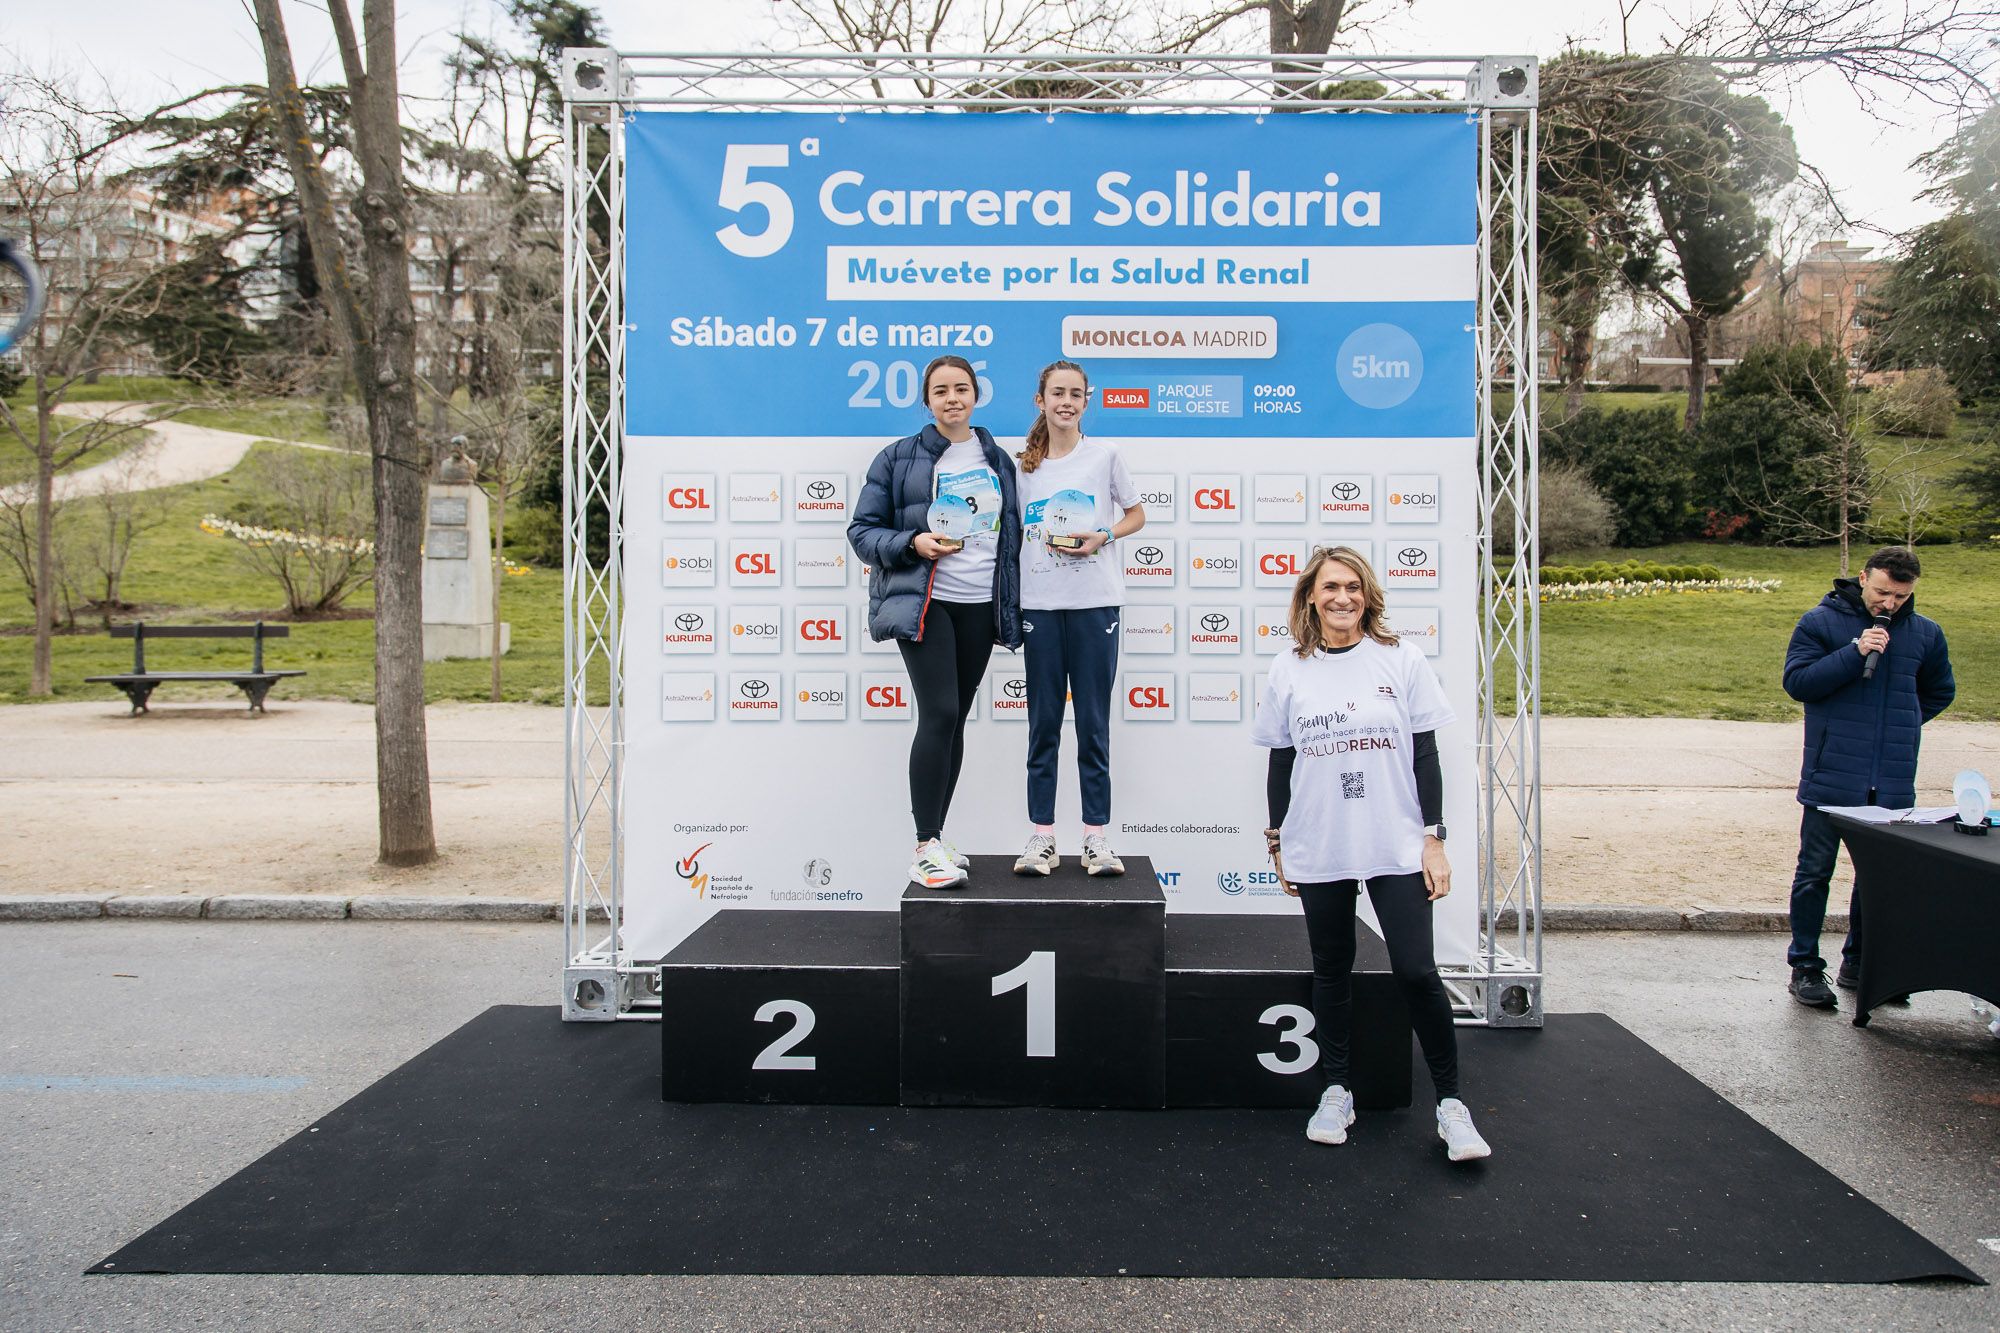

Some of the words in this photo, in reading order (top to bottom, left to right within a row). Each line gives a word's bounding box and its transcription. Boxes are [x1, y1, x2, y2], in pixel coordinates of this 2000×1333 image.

[819, 170, 1071, 226] Carrera
[1093, 170, 1380, 227] Solidaria
[848, 258, 991, 284] Muévete
[1003, 267, 1059, 291] por
[1070, 257, 1099, 284] la
[1111, 257, 1204, 284] Salud
[1217, 258, 1309, 284] Renal
[670, 316, 796, 346] Sábado
[806, 318, 827, 346] 7
[837, 316, 878, 346] de
[888, 324, 993, 347] marzo
[1072, 331, 1186, 346] MONCLOA
[1194, 331, 1266, 346] MADRID
[1352, 354, 1409, 378] 5km
[848, 361, 994, 409] 206
[1158, 384, 1213, 398] PARQUE
[1254, 384, 1296, 397] 09:00
[1107, 394, 1145, 404] SALIDA
[1158, 401, 1191, 413] DEL
[1193, 401, 1229, 413] OESTE
[1254, 401, 1301, 413] HORAS
[668, 488, 710, 509] CSL
[1140, 492, 1172, 504] sobi
[1195, 489, 1235, 510] CSL
[1403, 493, 1435, 504] sobi
[680, 557, 711, 568] sobi
[735, 553, 776, 574] CSL
[1206, 557, 1237, 569] sobi
[1259, 554, 1300, 575] CSL
[746, 623, 777, 635] sobi
[800, 620, 841, 640] CSL
[809, 690, 843, 702] sobi
[865, 687, 907, 707] CSL
[1129, 687, 1169, 708] CSL
[1297, 711, 1348, 733] Siempre
[1332, 728, 1357, 738] hacer
[1359, 726, 1378, 735] algo
[674, 824, 727, 834] Organizado
[730, 825, 748, 835] por:
[1122, 824, 1168, 832] Entidades
[1170, 824, 1239, 833] colaboradoras:
[992, 951, 1055, 1057] 1
[752, 999, 816, 1070] 2
[1257, 1004, 1319, 1074] 3
